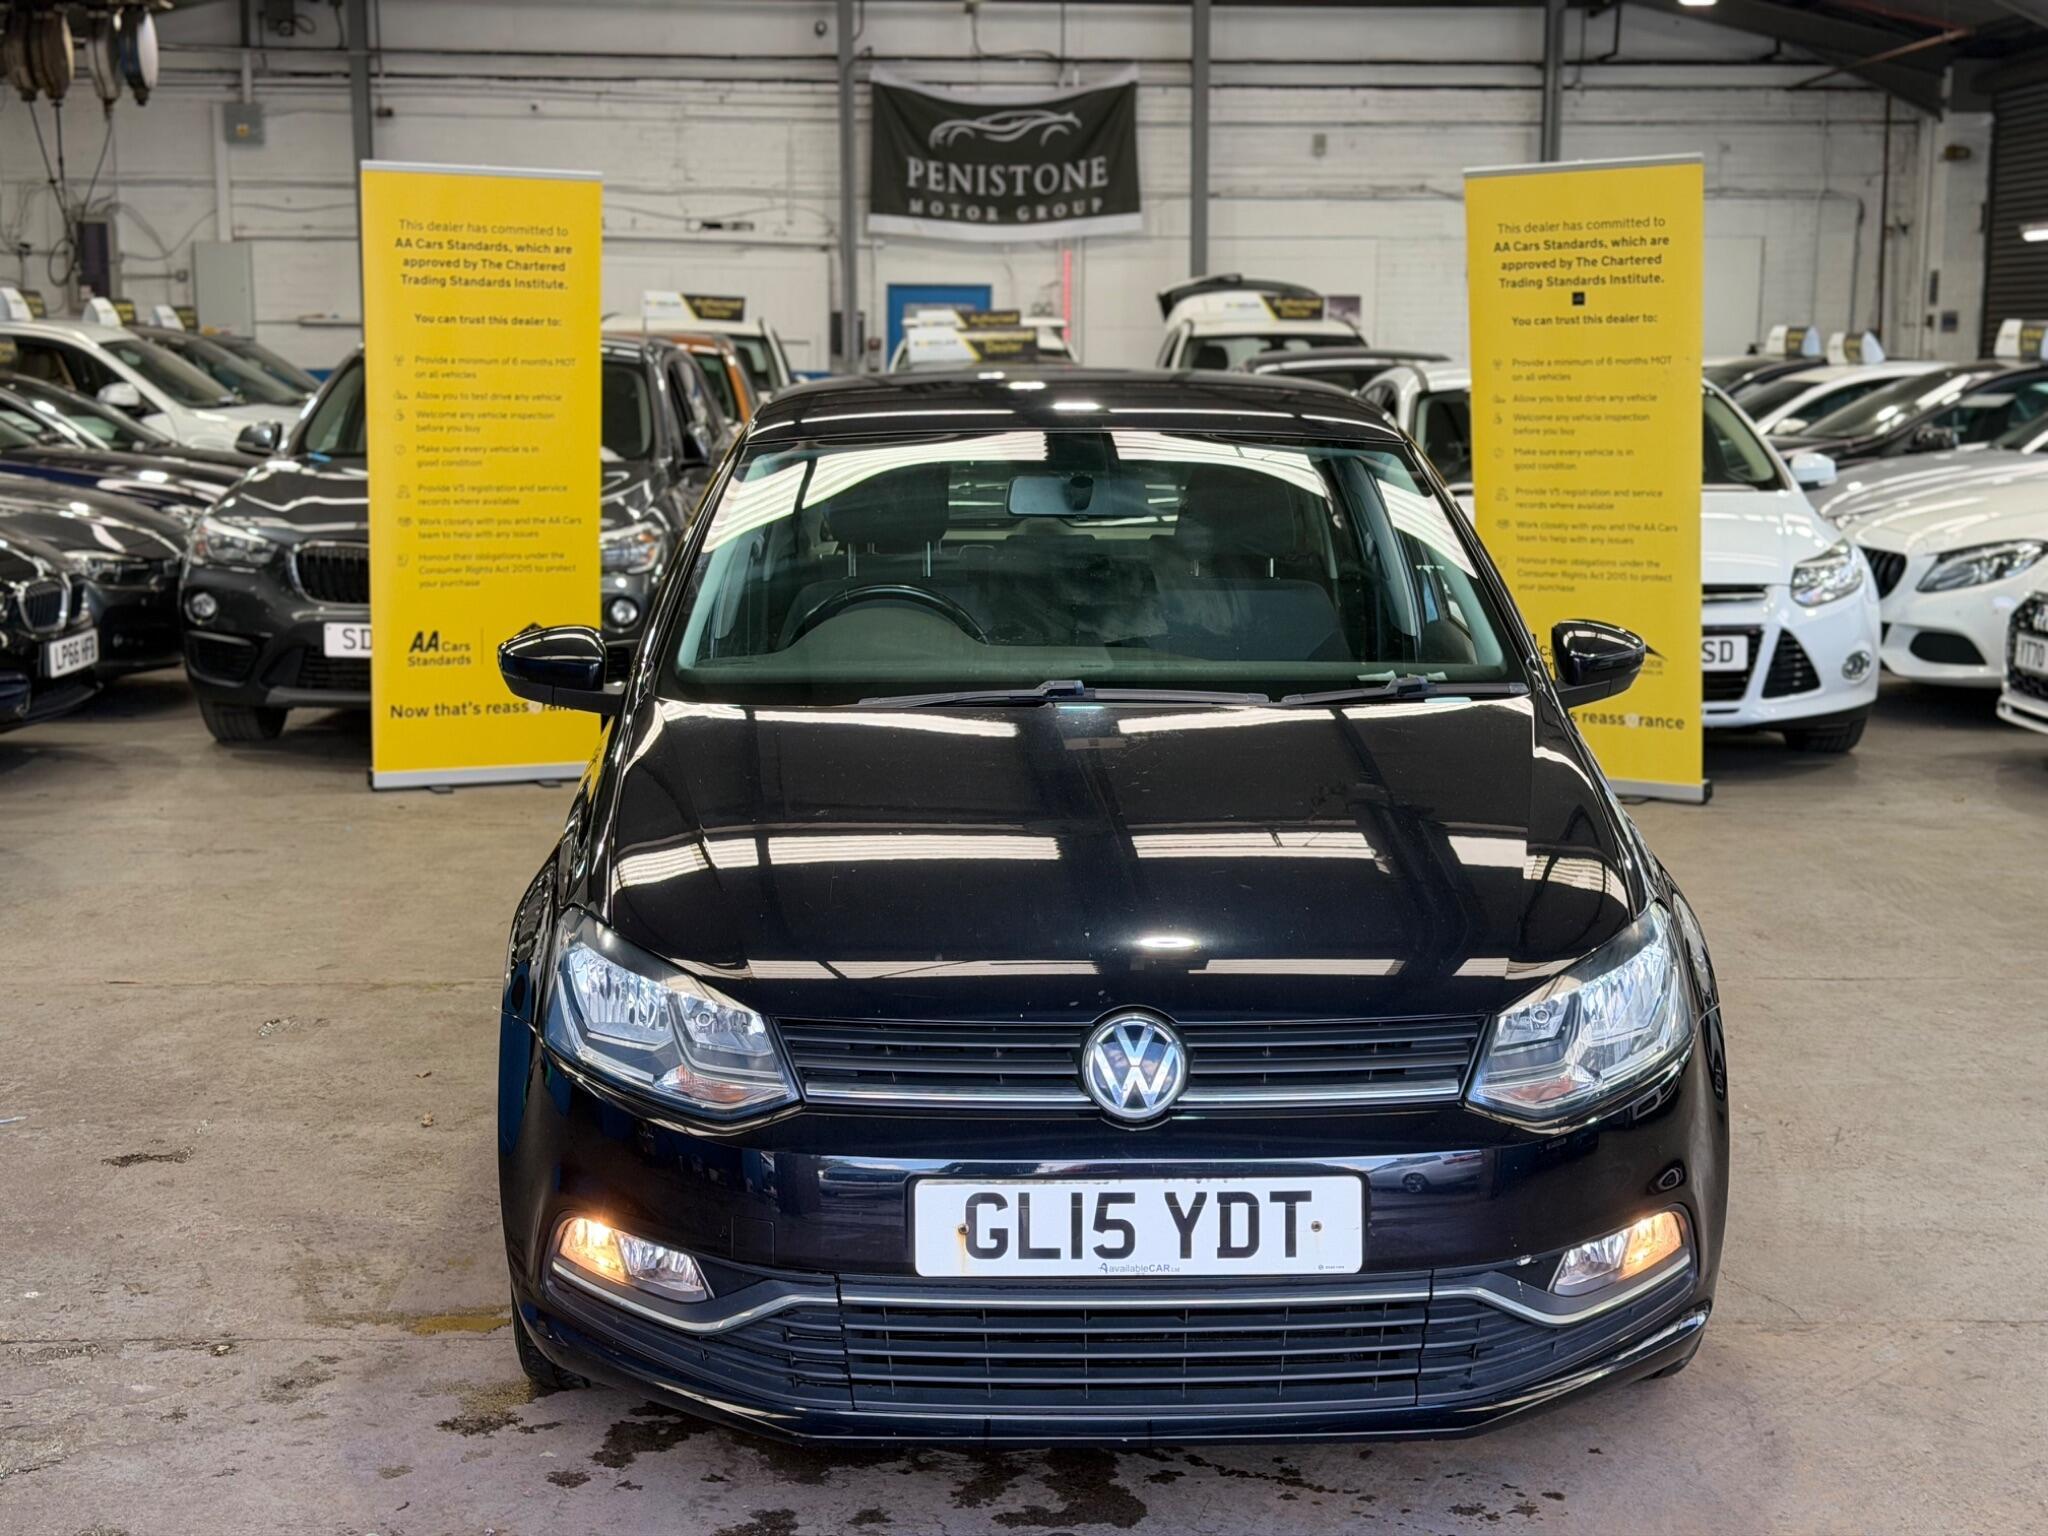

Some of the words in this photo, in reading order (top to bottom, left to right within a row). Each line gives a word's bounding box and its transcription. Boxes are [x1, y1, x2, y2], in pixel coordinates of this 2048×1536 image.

[906, 156, 1109, 197] PENISTONE
[909, 199, 998, 221] MOTOR
[1016, 198, 1103, 221] GROUP
[400, 220, 423, 231] This
[426, 221, 464, 232] dealer
[466, 223, 488, 233] has
[490, 224, 553, 235] committed
[556, 226, 568, 236] to
[1498, 223, 1521, 233] This
[1524, 221, 1560, 232] dealer
[1562, 220, 1583, 231] has
[1586, 218, 1650, 230] committed
[1653, 217, 1665, 227] to
[395, 238, 412, 248] AA
[415, 239, 443, 249] Cars
[446, 240, 512, 254] Standards,
[515, 242, 550, 253] which
[553, 245, 572, 254] are
[1494, 242, 1510, 252] AA
[1513, 241, 1540, 251] Cars
[1543, 239, 1608, 253] Standards,
[1610, 237, 1646, 248] which
[1650, 237, 1669, 246] are
[403, 258, 460, 271] approved
[462, 259, 478, 271] by
[480, 260, 502, 269] The
[505, 261, 565, 271] Chartered
[1501, 258, 1556, 272] approved
[1558, 258, 1573, 270] by
[1576, 257, 1598, 267] The
[1600, 255, 1662, 266] Chartered
[401, 275, 446, 288] Trading
[449, 276, 511, 288] Standards
[514, 278, 567, 289] Institute.
[1499, 277, 1542, 290] Trading
[1546, 276, 1606, 286] Standards
[1609, 274, 1664, 284] Institute.
[415, 314, 434, 323] You
[459, 315, 485, 324] trust
[488, 315, 508, 325] this
[510, 316, 544, 325] dealer
[547, 317, 561, 325] to:
[1512, 317, 1531, 326] You
[1555, 316, 1579, 325] trust
[1582, 316, 1602, 324] this
[1605, 315, 1639, 324] dealer
[1642, 314, 1657, 323] to:
[409, 630, 440, 653] AA
[441, 640, 471, 652] Cars
[407, 655, 472, 667] Standards
[390, 705, 429, 718] Now
[434, 702, 482, 716] that's
[965, 1191, 1136, 1260] GL15
[1164, 1190, 1312, 1259] YDT
